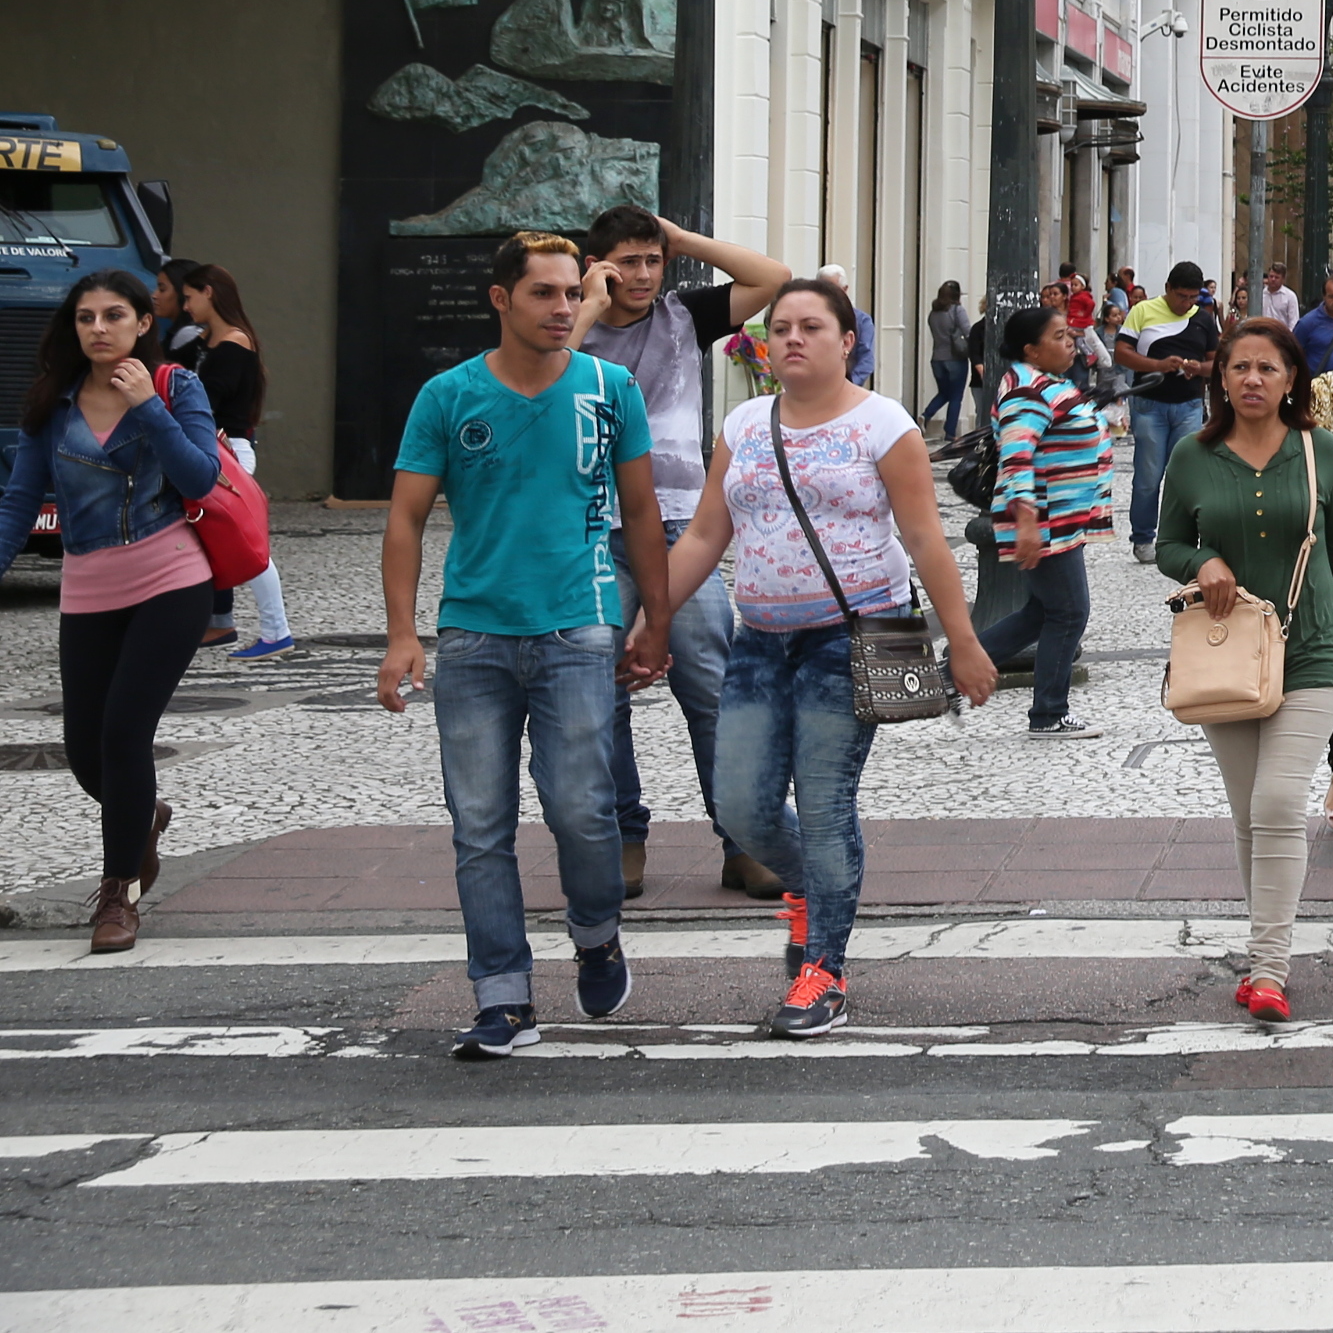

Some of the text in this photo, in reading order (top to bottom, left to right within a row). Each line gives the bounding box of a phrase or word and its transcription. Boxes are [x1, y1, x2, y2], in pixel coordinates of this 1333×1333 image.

[1219, 7, 1303, 22] Permitido
[1228, 22, 1293, 37] Ciclista
[1206, 37, 1316, 51] Desmontado
[1240, 65, 1283, 78] Evite
[1217, 78, 1305, 93] Acidentes
[10, 246, 26, 257] DE
[26, 247, 68, 258] VALOR
